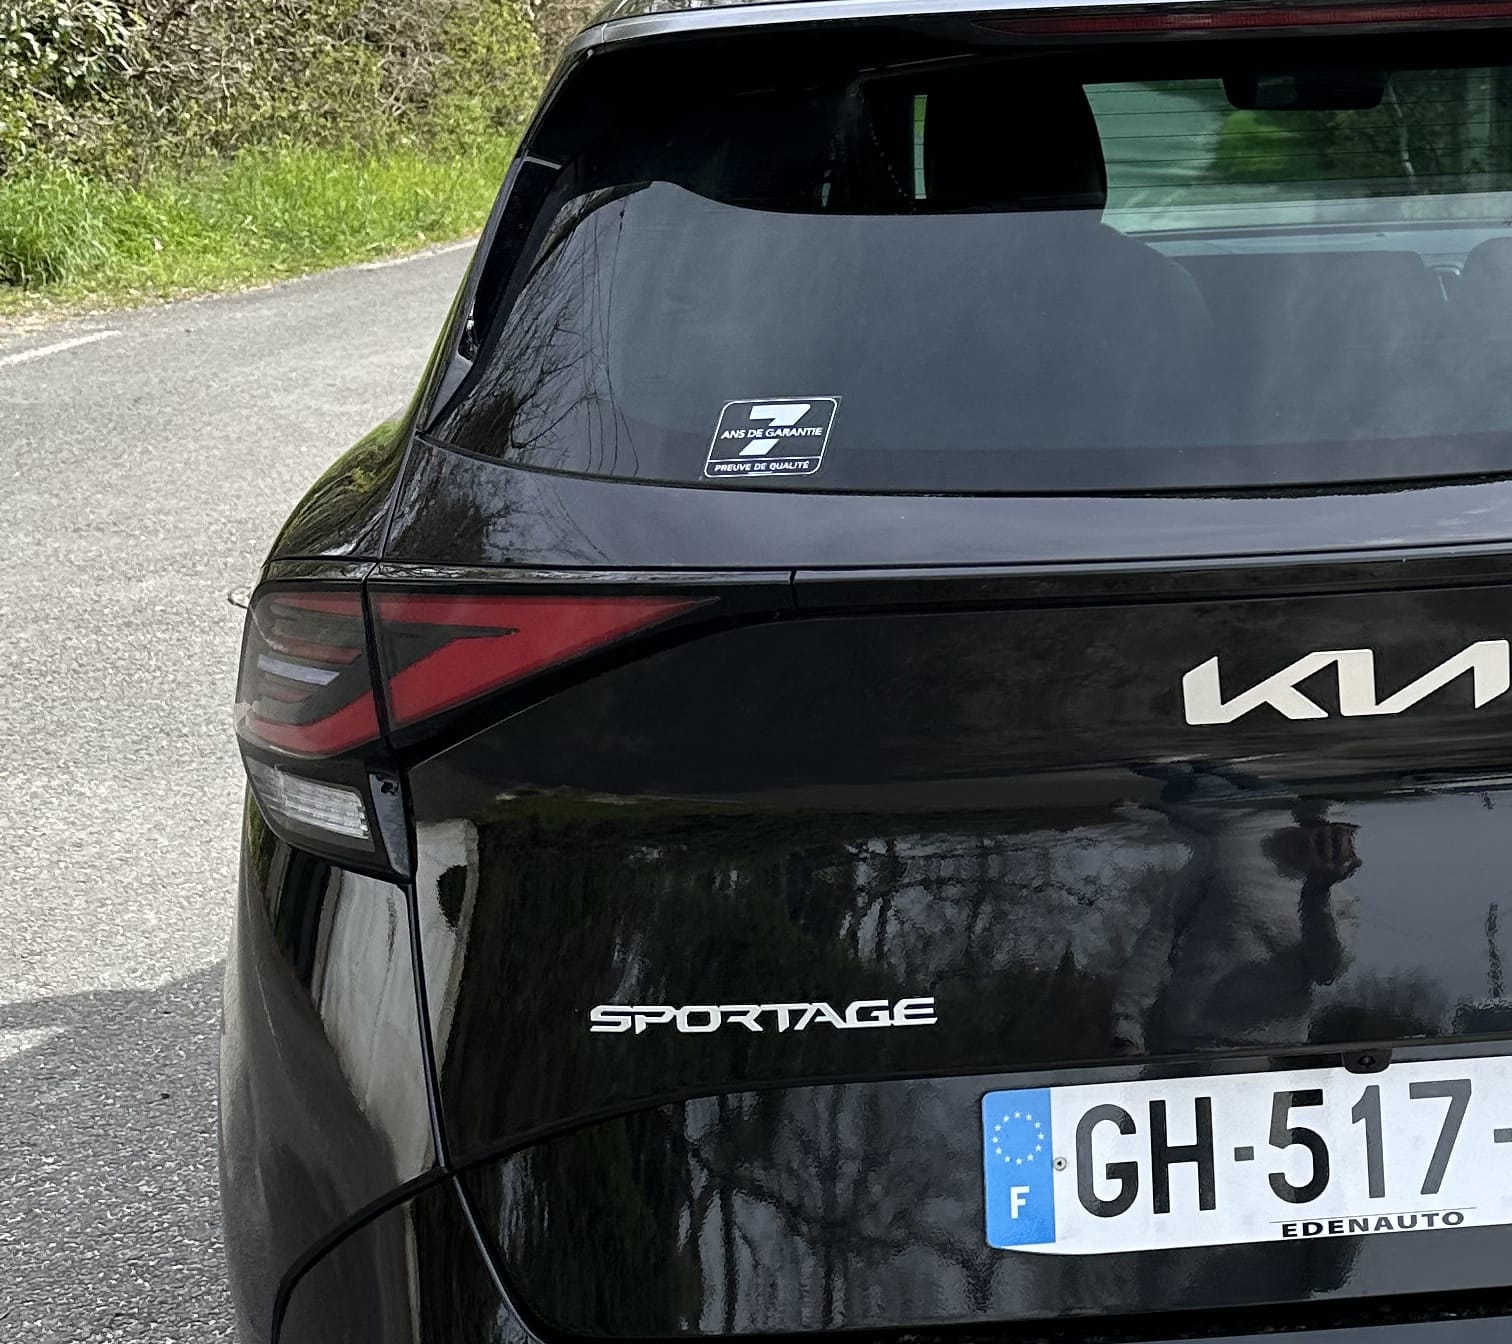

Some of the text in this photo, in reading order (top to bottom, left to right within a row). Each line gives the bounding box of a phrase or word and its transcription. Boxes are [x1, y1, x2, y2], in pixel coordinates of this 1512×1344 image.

[720, 427, 823, 439] ANS DE GARANTIE
[739, 403, 811, 456] 7
[714, 460, 809, 472] PREUVE DE QUALITÉ
[1182, 639, 1510, 725] KIA
[589, 997, 938, 1034] SPORTAGE
[1009, 1185, 1031, 1219] F
[1282, 1210, 1465, 1238] EDENAUTO
